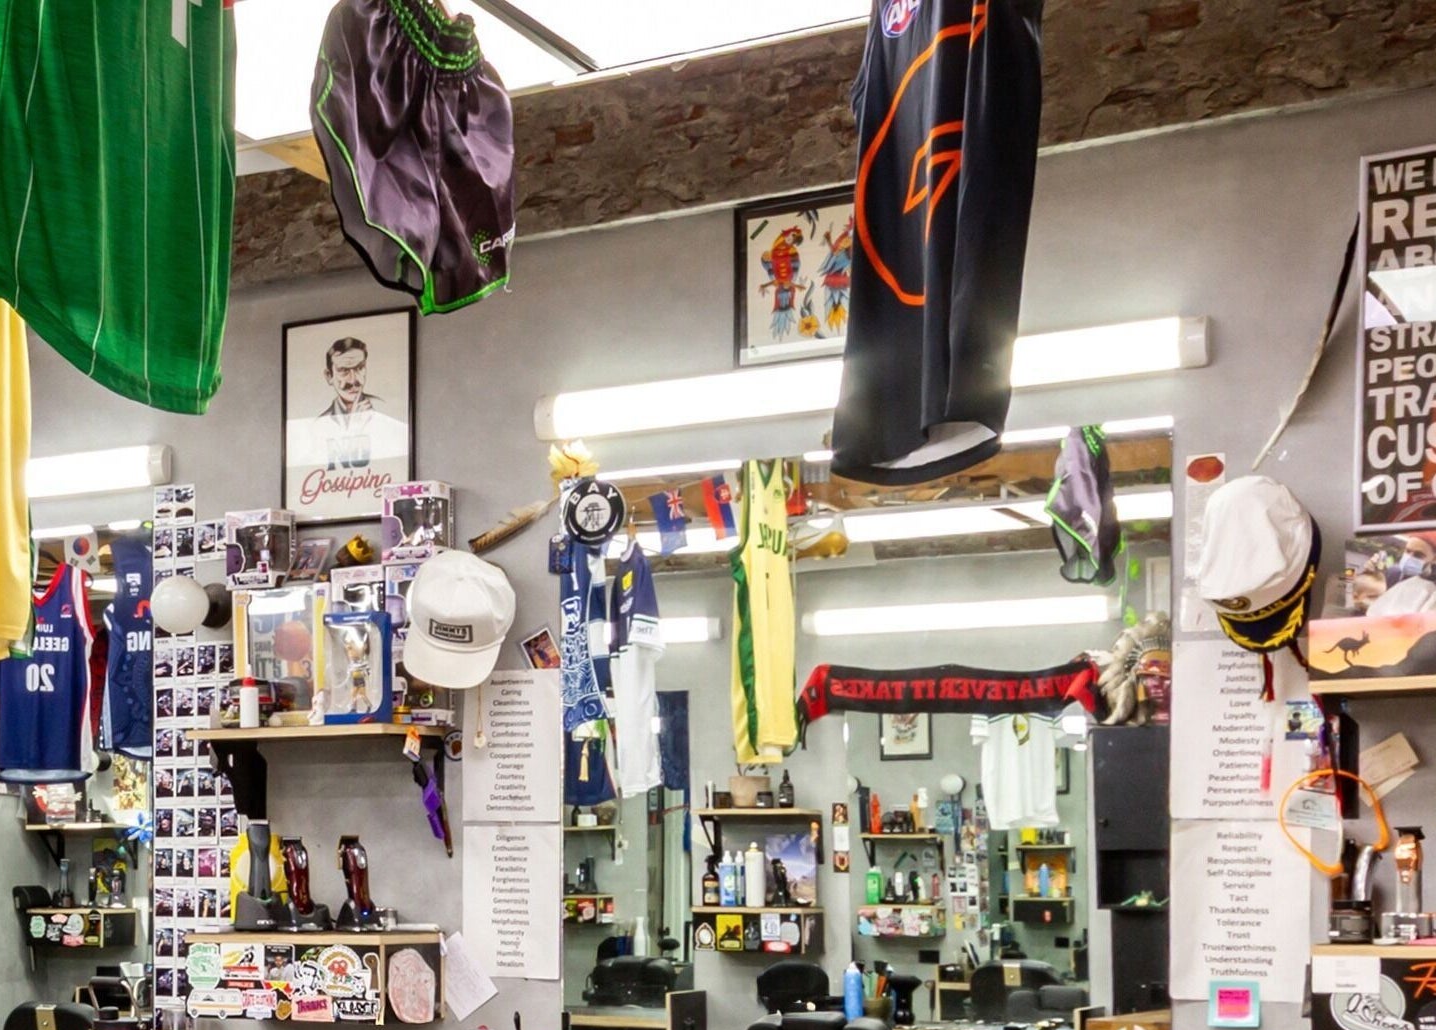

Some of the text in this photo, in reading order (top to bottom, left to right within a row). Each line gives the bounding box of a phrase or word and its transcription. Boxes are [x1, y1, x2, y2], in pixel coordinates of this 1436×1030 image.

[1373, 159, 1426, 195] WE
[326, 434, 371, 470] NO
[300, 468, 392, 504] Gossiping
[1366, 471, 1424, 504] OF
[569, 482, 618, 505] BAY
[1223, 712, 1257, 720] Loyalty
[1219, 737, 1260, 745] Modesty
[1208, 774, 1259, 782] Peacefulne
[1216, 832, 1262, 841] Reliability
[1222, 844, 1257, 852] Respect
[1205, 857, 1272, 865] Responsibility
[1206, 869, 1272, 877] Self-Discipline
[493, 897, 528, 905] Generosity
[1229, 894, 1248, 902] Tact
[1209, 906, 1269, 914] Thankfulness
[1216, 919, 1262, 927] Tolerance
[1226, 931, 1250, 939] Trust
[1205, 956, 1273, 965] Understanding
[1210, 968, 1268, 977] Truthfulness
